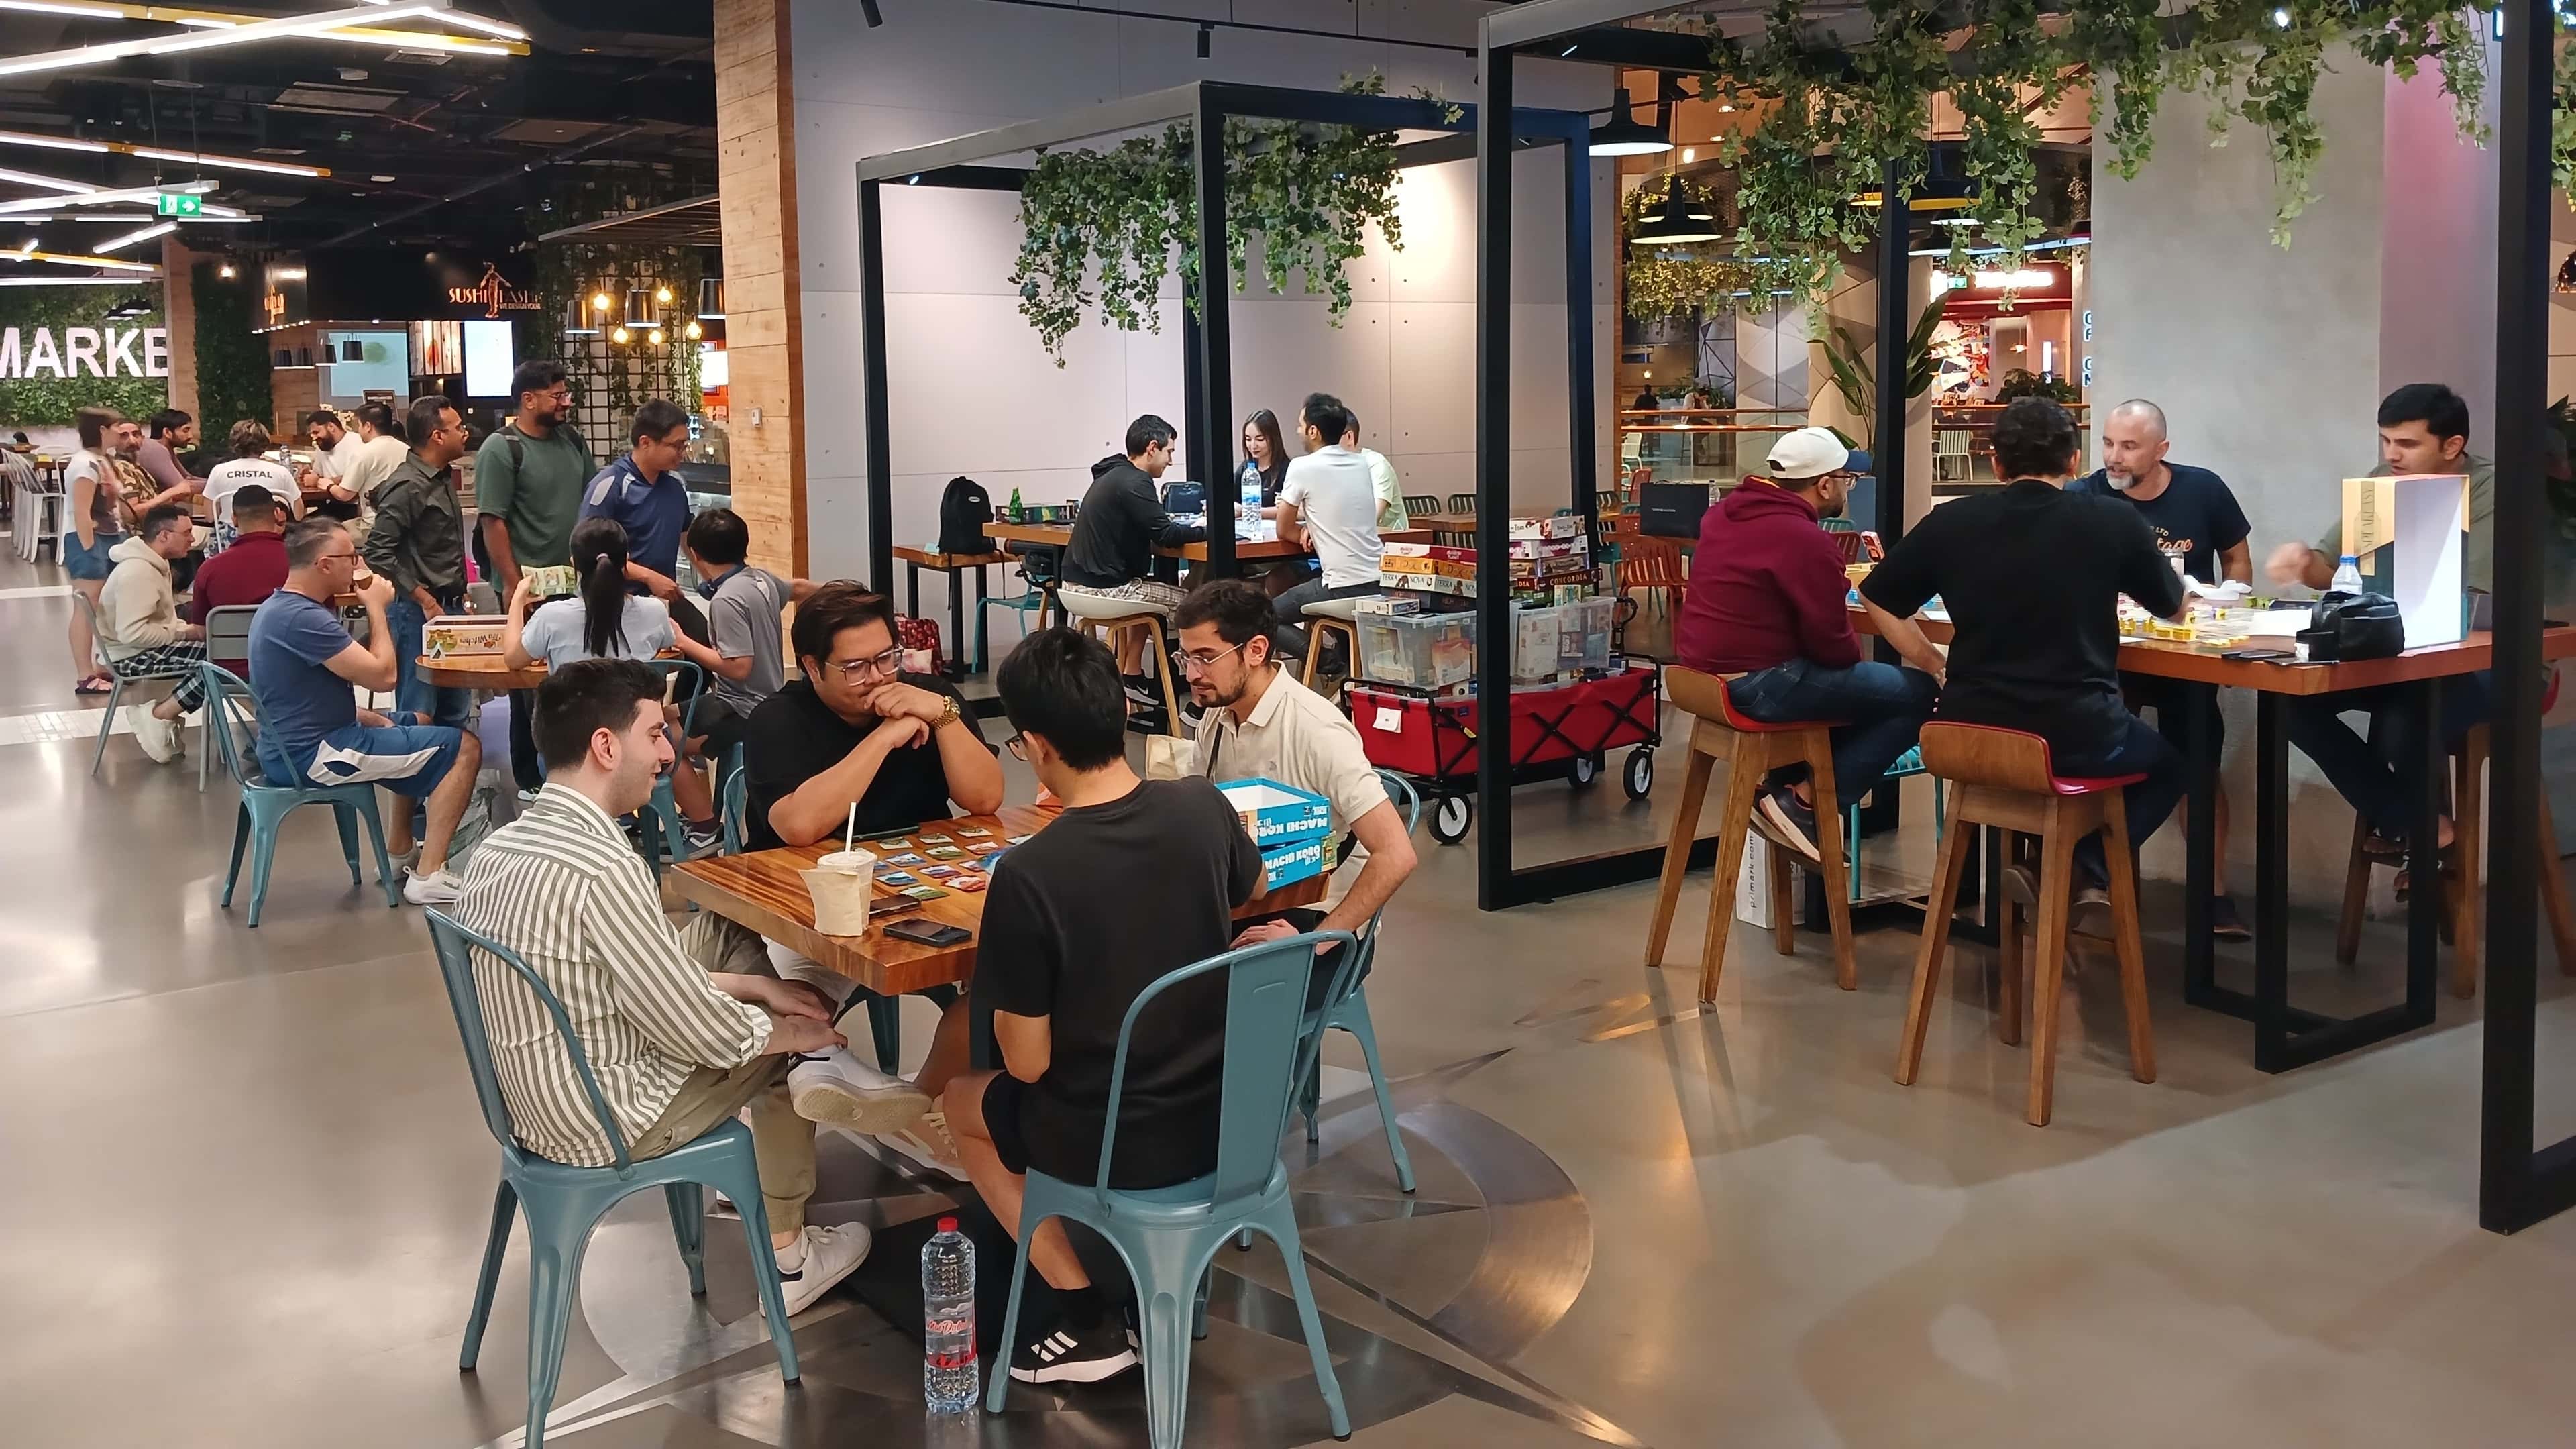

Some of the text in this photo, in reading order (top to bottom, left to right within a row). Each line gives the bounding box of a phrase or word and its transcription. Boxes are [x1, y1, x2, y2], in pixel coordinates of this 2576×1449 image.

[449, 288, 488, 303] SUSHI
[227, 470, 273, 478] CRISTAL
[2155, 527, 2169, 536] LTD
[1438, 579, 1452, 588] TERRA
[1550, 574, 1587, 586] CONCORDIA
[1287, 818, 1328, 833] MACHI
[1265, 853, 1295, 870] MACHI
[1296, 845, 1320, 861] KORO
